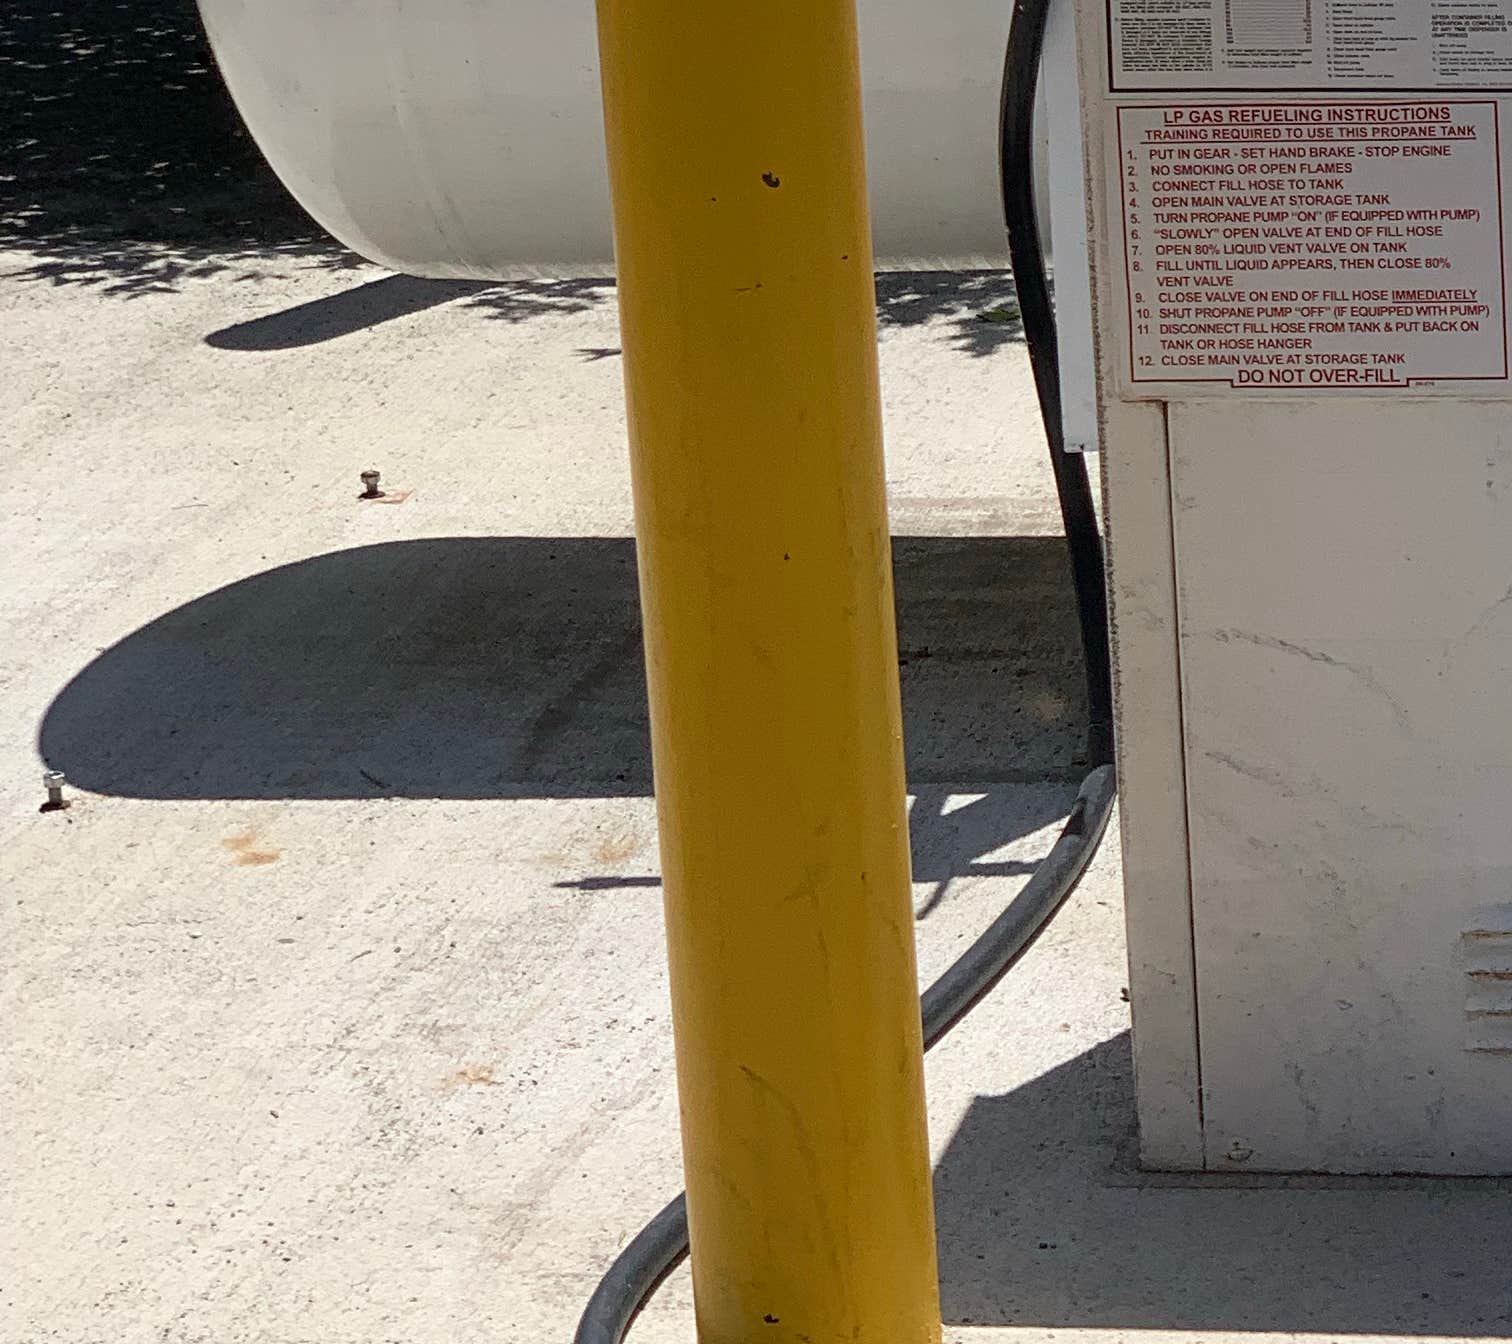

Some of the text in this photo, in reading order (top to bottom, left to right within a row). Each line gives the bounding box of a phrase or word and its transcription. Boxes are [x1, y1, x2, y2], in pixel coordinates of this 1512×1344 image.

[1163, 106, 1450, 124] LP GAS REFUELING INSTRUCTIONS
[1144, 125, 1476, 143] TRAINING REQUIRED TO USE THIS PROPANE TANK
[1127, 149, 1137, 160] 1.
[1149, 148, 1174, 160] PUT
[1177, 148, 1190, 159] IN
[1193, 148, 1231, 159] GEAR
[1240, 147, 1266, 159] SET
[1269, 147, 1306, 158] HAND
[1309, 146, 1355, 158] BRAKE
[1365, 145, 1400, 157] STOP
[1402, 144, 1451, 157] ENGINE
[1127, 162, 1352, 176] 2. NO SMOKING OR OPEN FLAMES
[1128, 178, 1344, 192] 3. CONNECT FILL HOSE TO TANK
[1129, 194, 1390, 208] 4. OPEN MAIN VALVE AT STORAGE TANK
[1130, 212, 1140, 224] 5.
[1152, 212, 1188, 223] TURN
[1190, 211, 1250, 223] PROPANE
[1253, 211, 1289, 222] PUMP
[1324, 210, 1339, 224] (IF
[1341, 209, 1404, 221] EQUIPPED
[1405, 209, 1438, 220] WITH
[1440, 208, 1480, 222] PUMP)
[1132, 260, 1143, 272] 8.
[1155, 260, 1183, 271] FILL
[1185, 259, 1223, 271] UNTIL
[1225, 259, 1268, 271] LIQUID
[1271, 258, 1336, 271] APPEARS,
[1339, 258, 1374, 269] THEN
[1377, 257, 1422, 269] CLOSE
[1156, 275, 1233, 287] VENT VALVE
[1135, 289, 1478, 303] 9. CLOSE VALVE ON END OF FILL HOSE IMMEDIATELY
[1161, 354, 1205, 366] CLOSE
[1207, 354, 1240, 365] MAIN
[1242, 354, 1284, 365] VALVE
[1285, 353, 1302, 364] AT
[1304, 353, 1368, 365] STORAGE
[1370, 353, 1405, 364] TANK
[1237, 368, 1400, 386] DO NOT OVER-FILL
